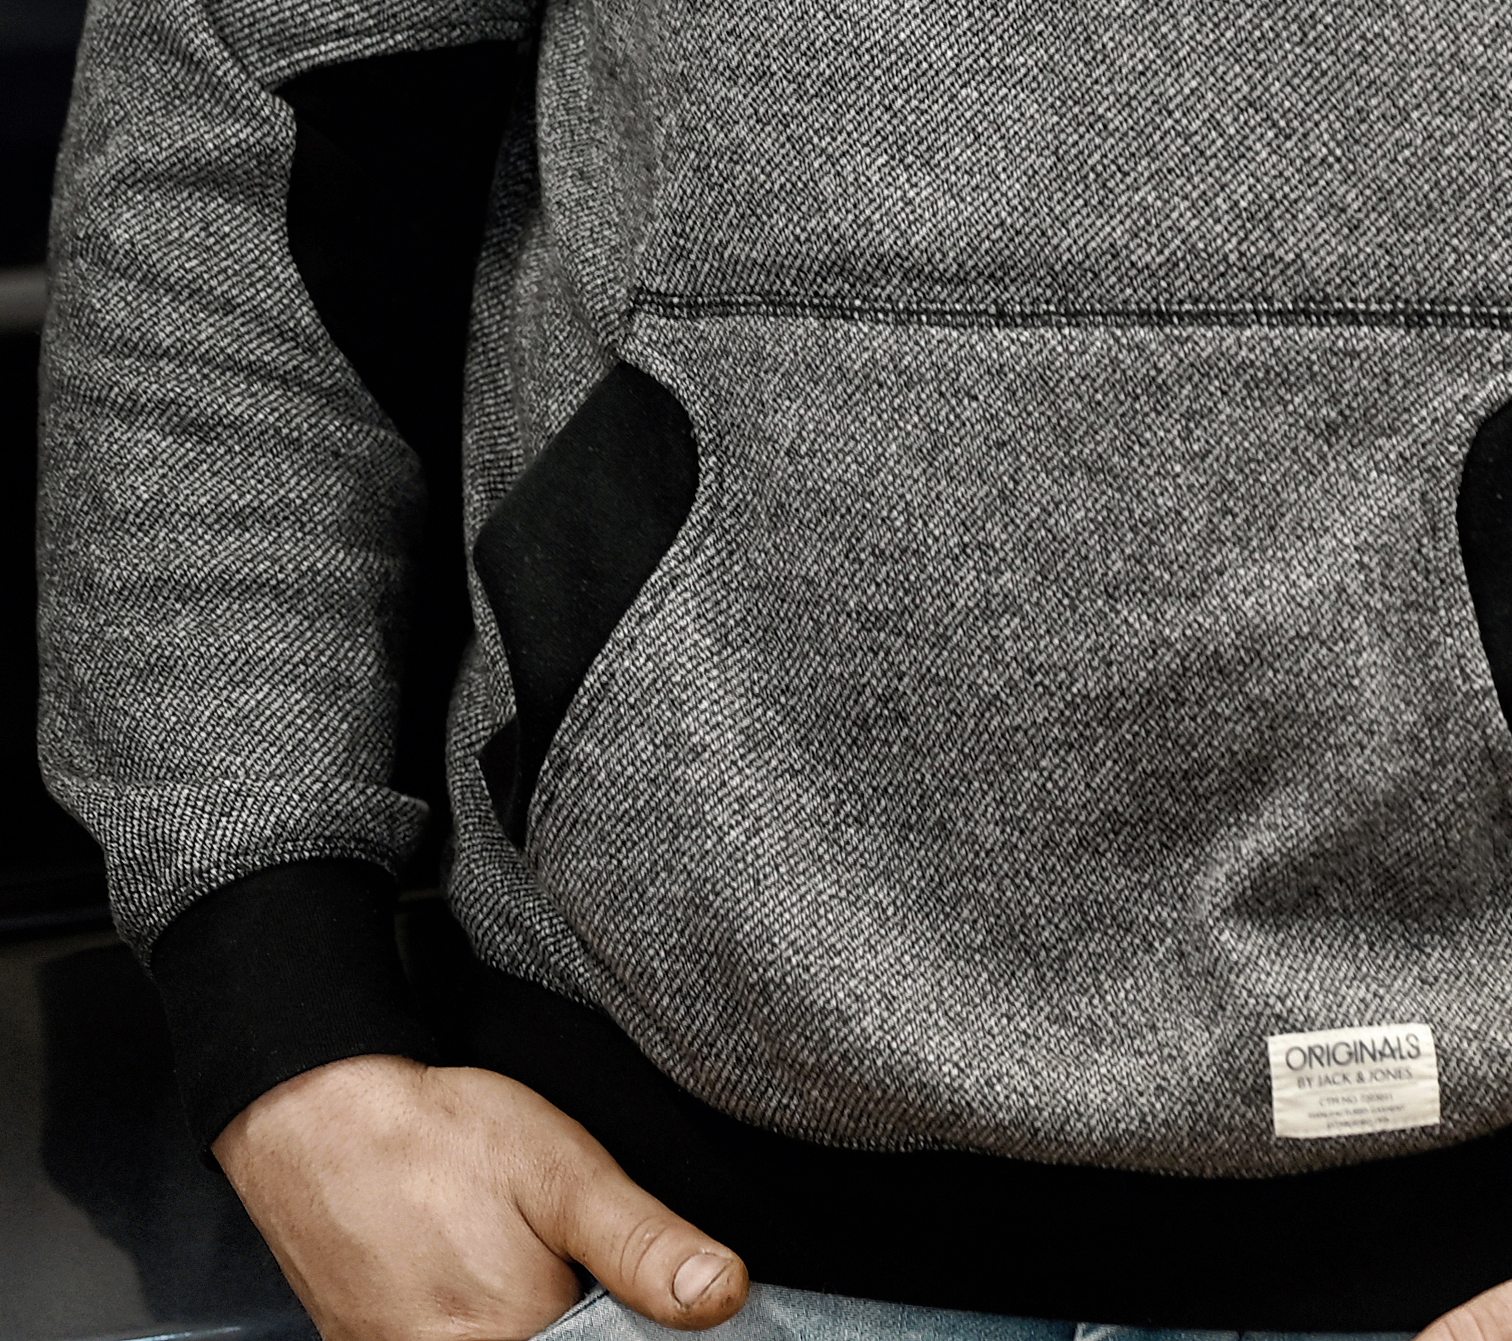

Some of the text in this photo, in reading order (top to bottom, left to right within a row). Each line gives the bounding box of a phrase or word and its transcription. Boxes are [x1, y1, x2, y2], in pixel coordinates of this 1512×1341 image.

[1285, 1033, 1422, 1071] ORIGINALS
[1297, 1067, 1413, 1089] BY JACK & JONES
